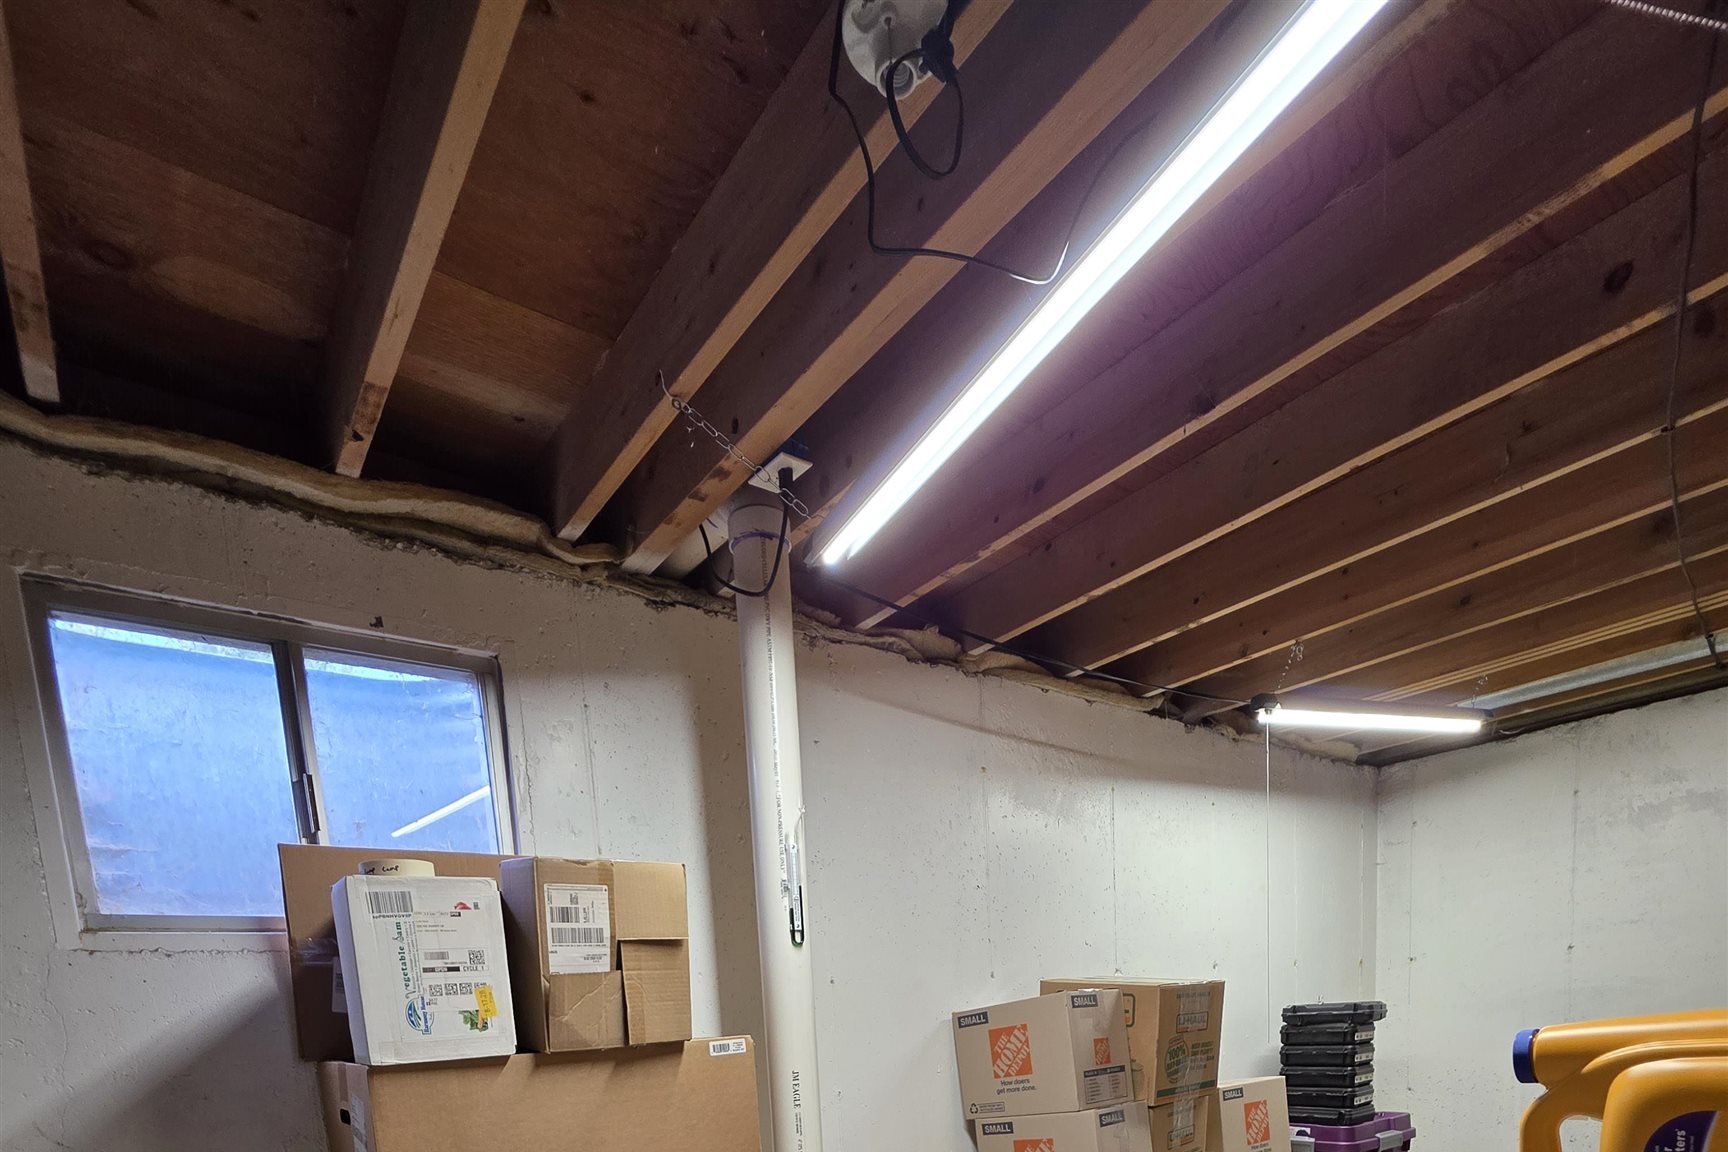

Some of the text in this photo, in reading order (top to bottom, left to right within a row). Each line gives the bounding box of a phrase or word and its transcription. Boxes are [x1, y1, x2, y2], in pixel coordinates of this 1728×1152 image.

[398, 945, 416, 999] Vegetable
[1073, 996, 1096, 1006] SMALL
[960, 1014, 986, 1026] SMALL
[993, 1032, 1010, 1053] THE
[993, 1024, 1029, 1078] HOME
[1008, 1043, 1030, 1076] DEPOT
[791, 1070, 800, 1082] JM
[996, 1087, 1006, 1095] get
[1021, 1084, 1037, 1092] done.
[1224, 1089, 1242, 1099] SMALL
[792, 1083, 801, 1109] EAGLE
[1101, 1112, 1124, 1125] SMALL
[984, 1123, 1011, 1134] SMALL
